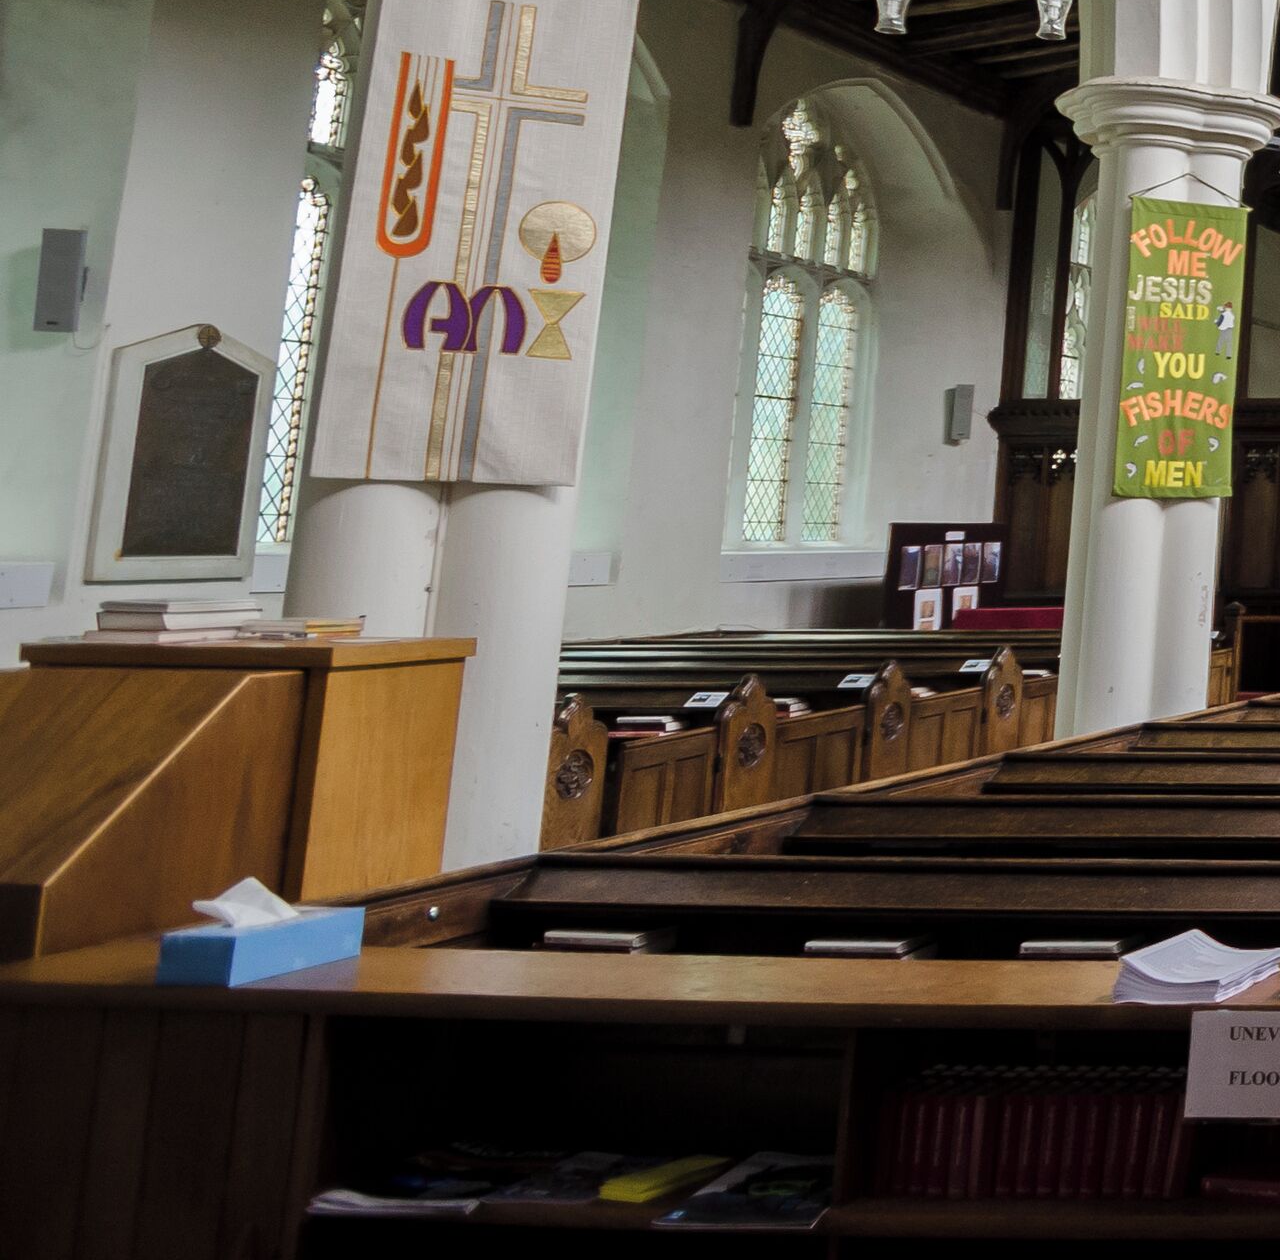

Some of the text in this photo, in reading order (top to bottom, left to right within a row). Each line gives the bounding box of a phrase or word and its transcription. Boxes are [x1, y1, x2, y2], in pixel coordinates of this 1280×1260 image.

[1130, 218, 1243, 267] FOLLOW
[1167, 249, 1208, 279] ME
[1128, 274, 1213, 305] JESUS
[1159, 302, 1210, 320] SAID
[1126, 332, 1185, 351] MAKE
[1153, 351, 1206, 380] YOU
[1119, 389, 1233, 430] FISHERS
[1157, 428, 1196, 456] OF
[1144, 460, 1204, 487] MEN
